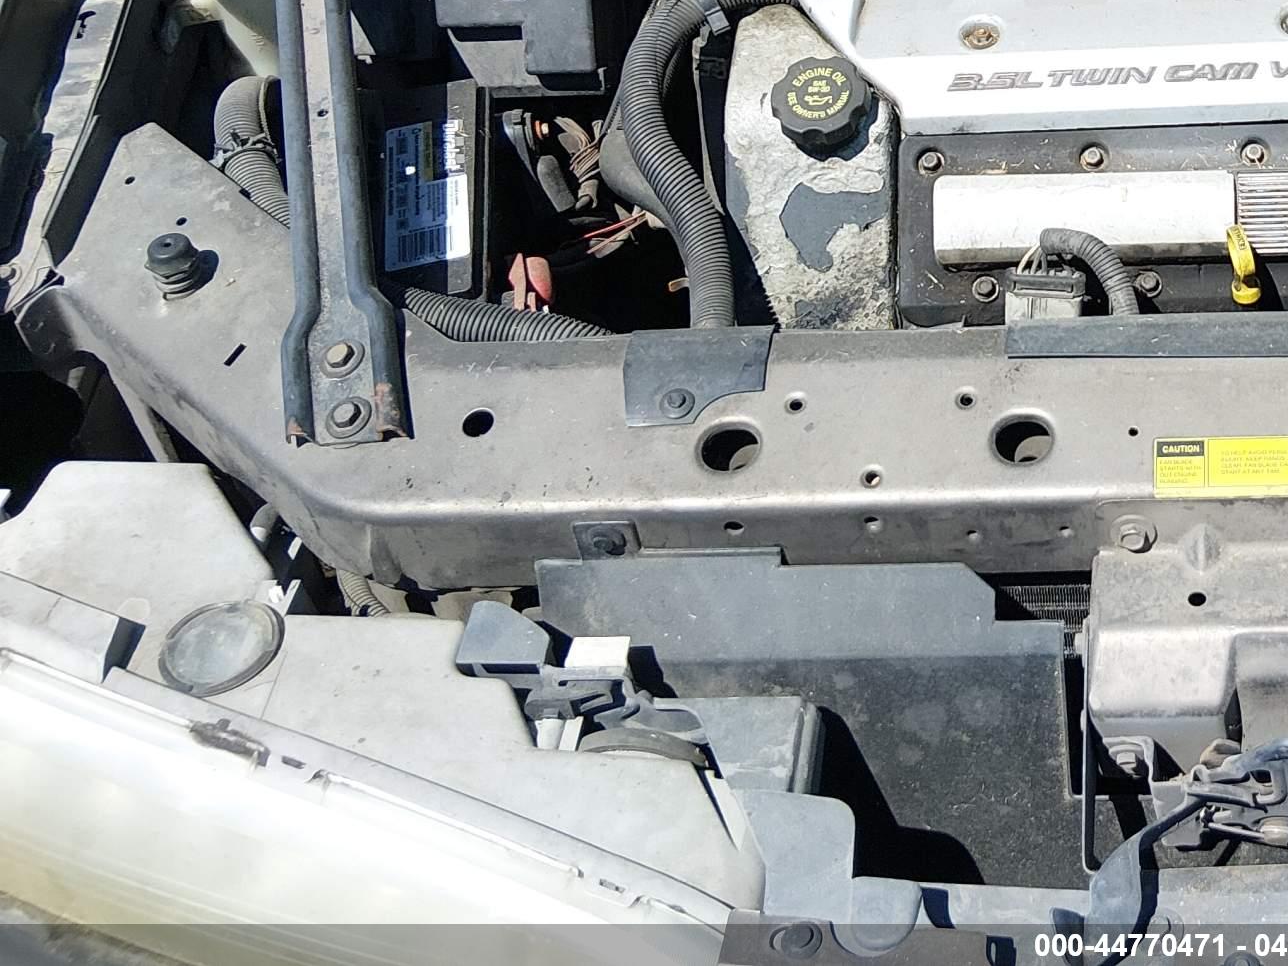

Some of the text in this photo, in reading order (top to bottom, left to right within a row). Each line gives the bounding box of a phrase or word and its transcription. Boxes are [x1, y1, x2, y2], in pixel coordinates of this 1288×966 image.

[791, 67, 847, 87] ENGINE OIL
[947, 71, 1044, 92] 3.5L
[1048, 66, 1158, 88] TWIN
[1164, 62, 1260, 83] CAM
[825, 90, 849, 115] MANUAL
[1162, 445, 1200, 453] CAUTION
